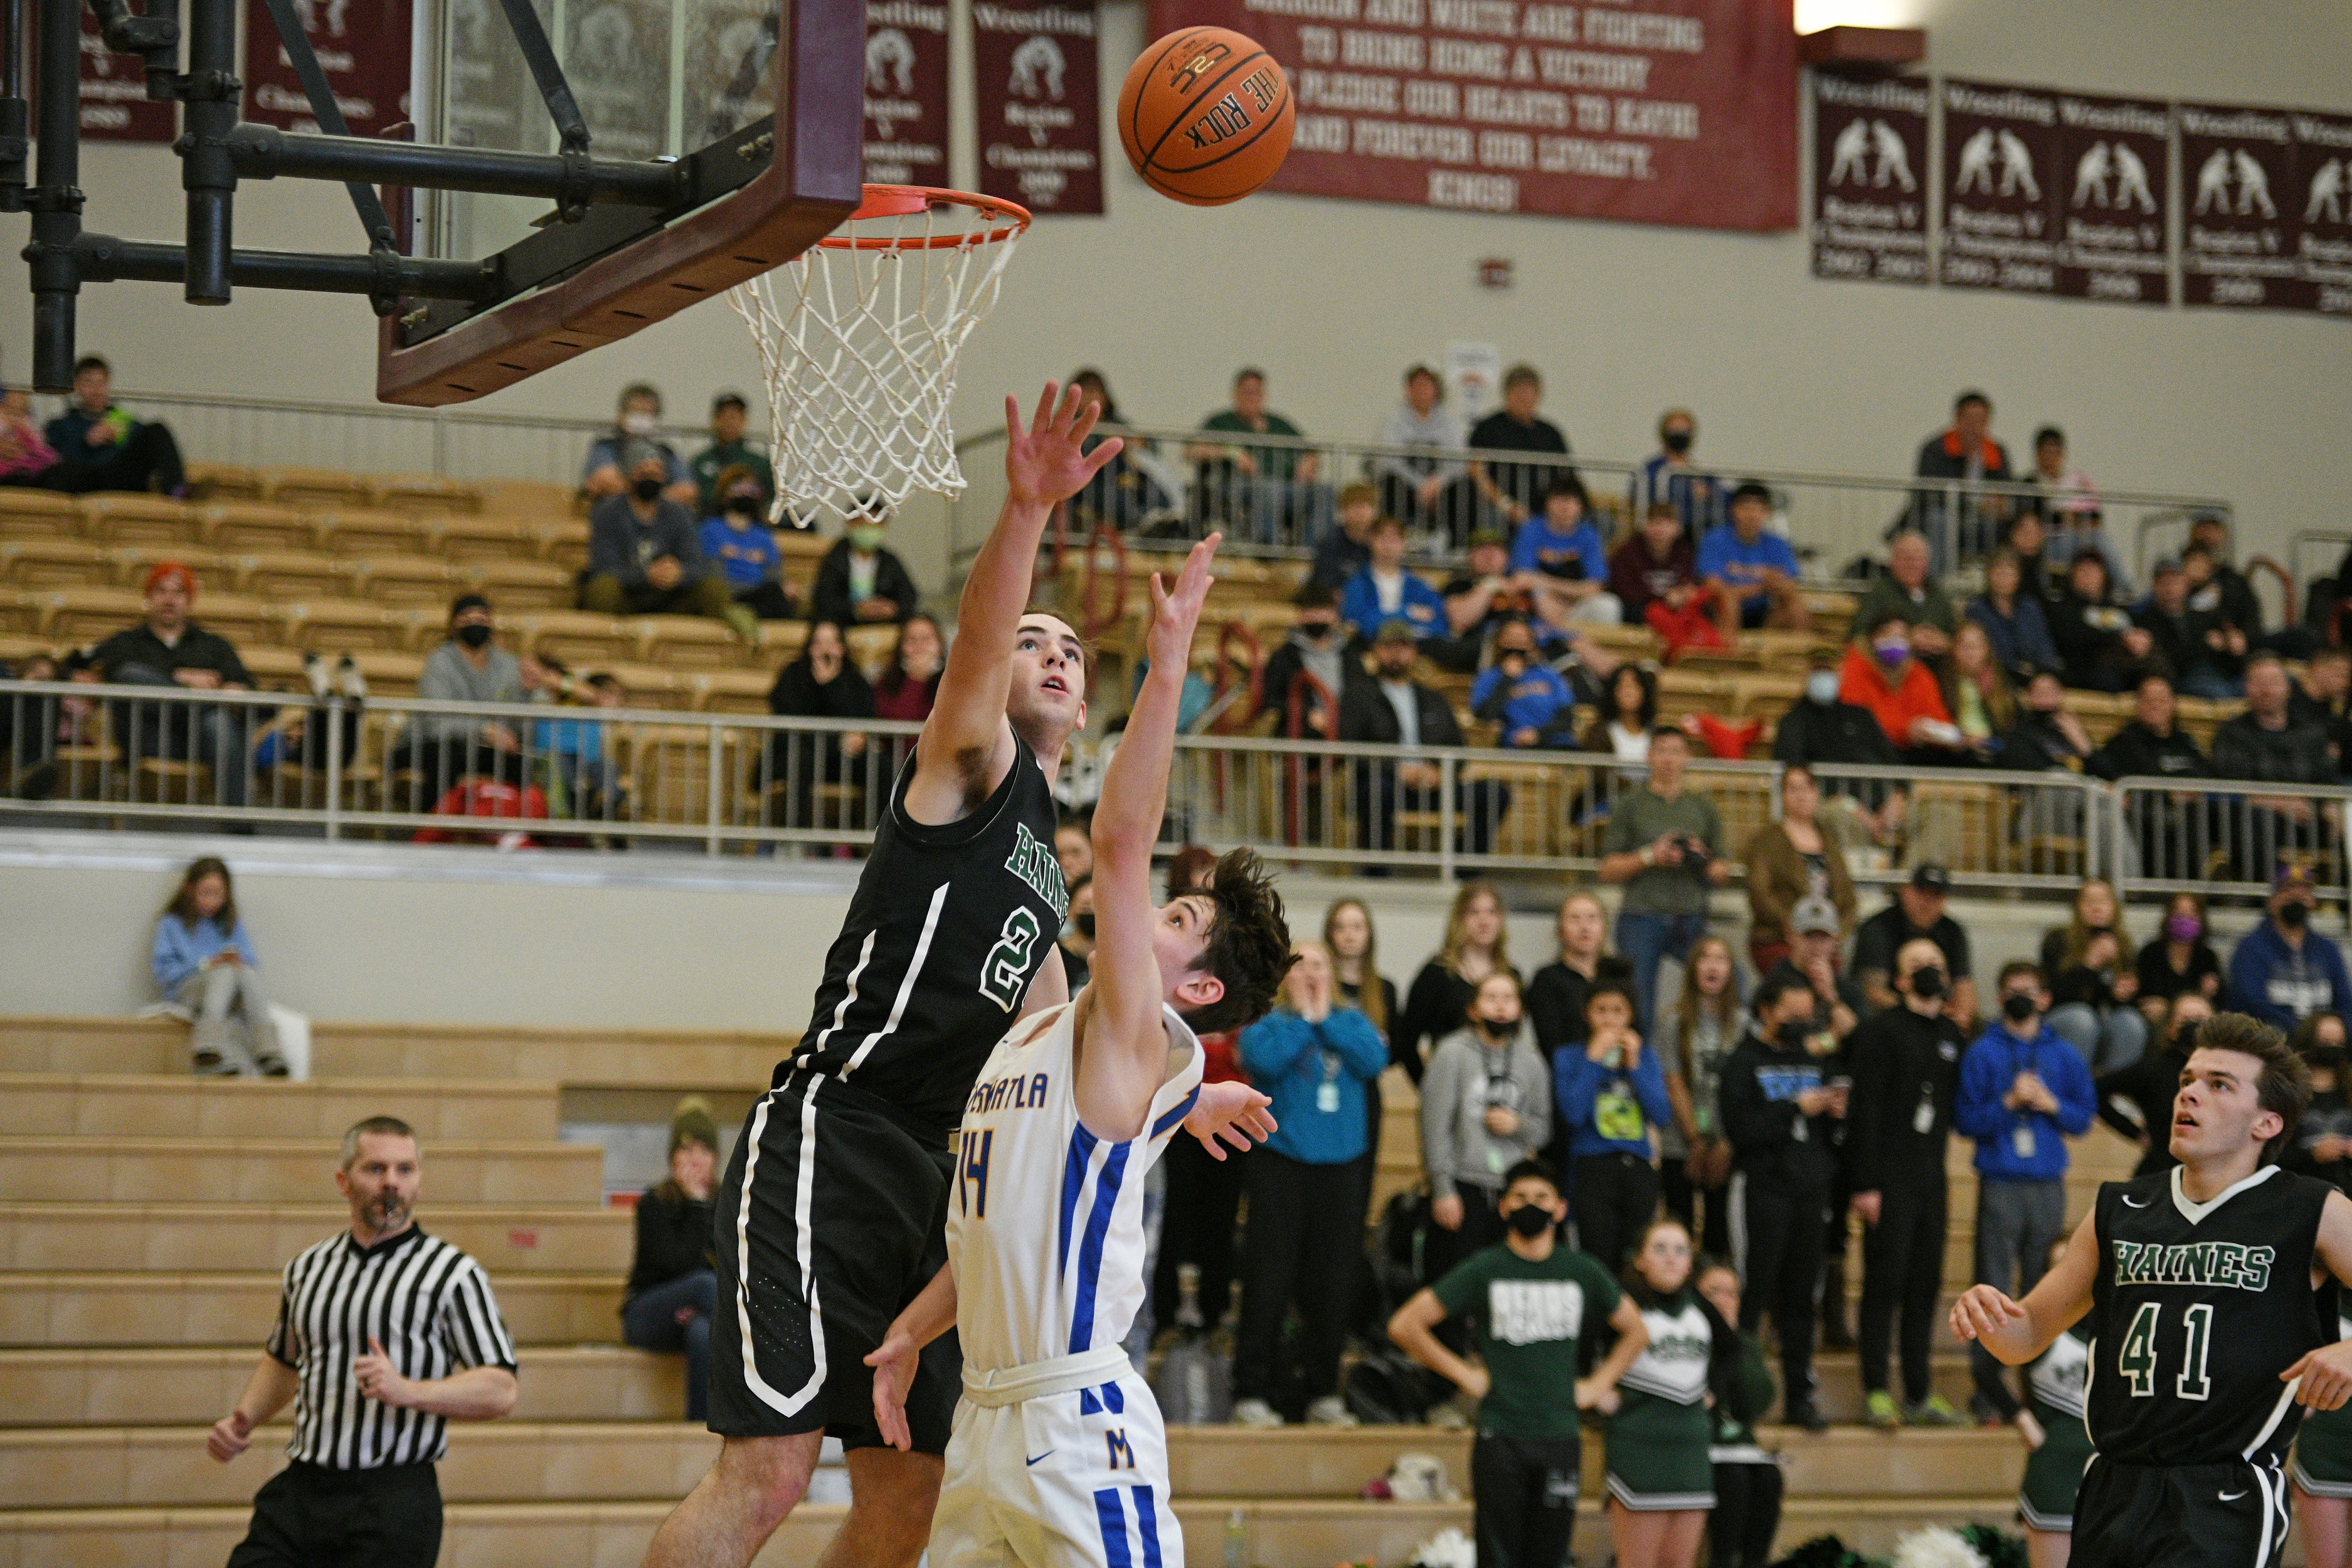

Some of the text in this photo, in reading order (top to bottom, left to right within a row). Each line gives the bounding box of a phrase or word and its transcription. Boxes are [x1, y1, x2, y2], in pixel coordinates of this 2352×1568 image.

[1298, 26, 1651, 92] TO BRING HOME A VICTORY
[1184, 92, 1252, 149] ROCK
[1241, 66, 1279, 115] THE
[1300, 69, 1400, 112] PLEDGE
[1404, 80, 1459, 119] OUR
[1465, 84, 1571, 129] HEARTS
[1573, 93, 1610, 132] TO
[1353, 118, 1475, 164] FOREVER
[1478, 130, 1534, 169] OUR
[978, 906, 1040, 1014] 2
[959, 1128, 995, 1221] 14
[2112, 1239, 2275, 1292] HAINES
[2119, 1301, 2213, 1401] 41
[1104, 1428, 1136, 1471] M
